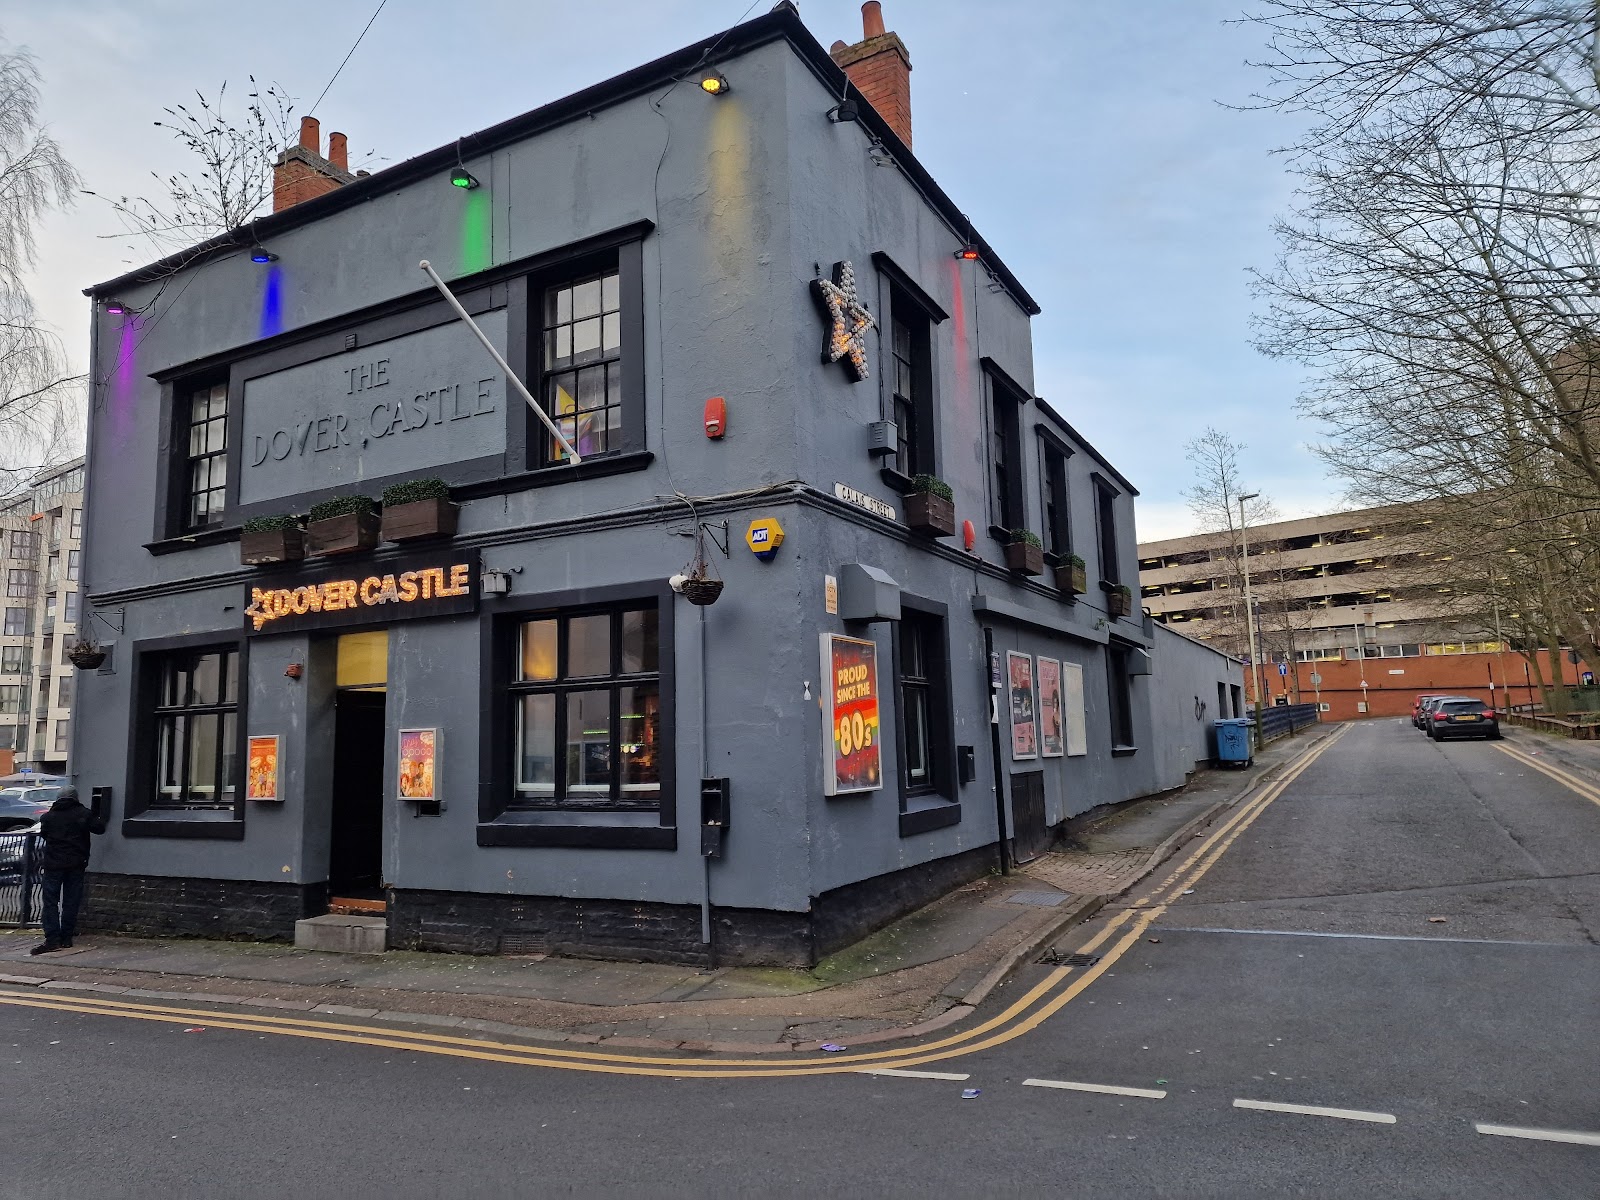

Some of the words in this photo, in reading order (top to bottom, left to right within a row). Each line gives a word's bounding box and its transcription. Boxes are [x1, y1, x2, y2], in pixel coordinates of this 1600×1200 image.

[344, 358, 390, 395] THE
[252, 414, 350, 467] DOVER
[369, 376, 496, 438] CASTLE
[842, 487, 865, 507] CALAIS
[870, 499, 890, 517] STREET
[752, 530, 768, 541] ADT
[274, 579, 358, 617] DOVER
[360, 564, 469, 605] CASTLE
[837, 664, 868, 687] PROUD
[836, 685, 856, 704] SINCE
[856, 681, 871, 697] THE
[840, 712, 872, 755] 80s
